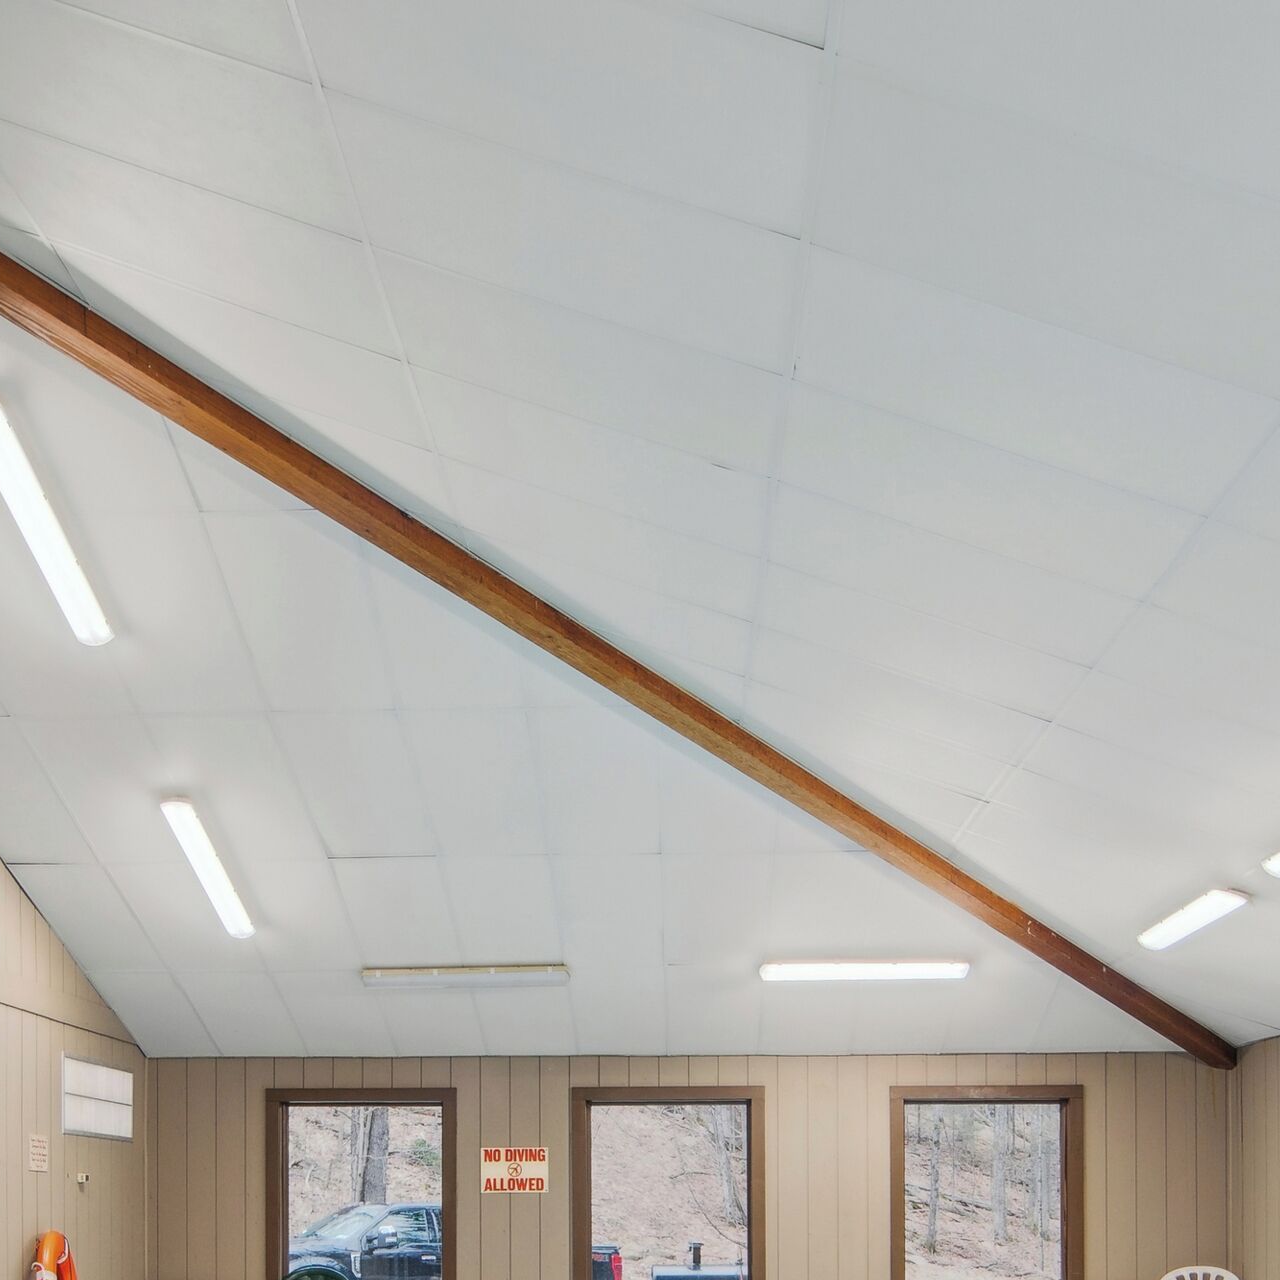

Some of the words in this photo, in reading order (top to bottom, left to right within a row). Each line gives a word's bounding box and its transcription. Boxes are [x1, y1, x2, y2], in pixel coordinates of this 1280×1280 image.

[484, 1149, 500, 1162] NO
[505, 1149, 546, 1162] DIVING
[484, 1178, 544, 1192] ALLOWED
